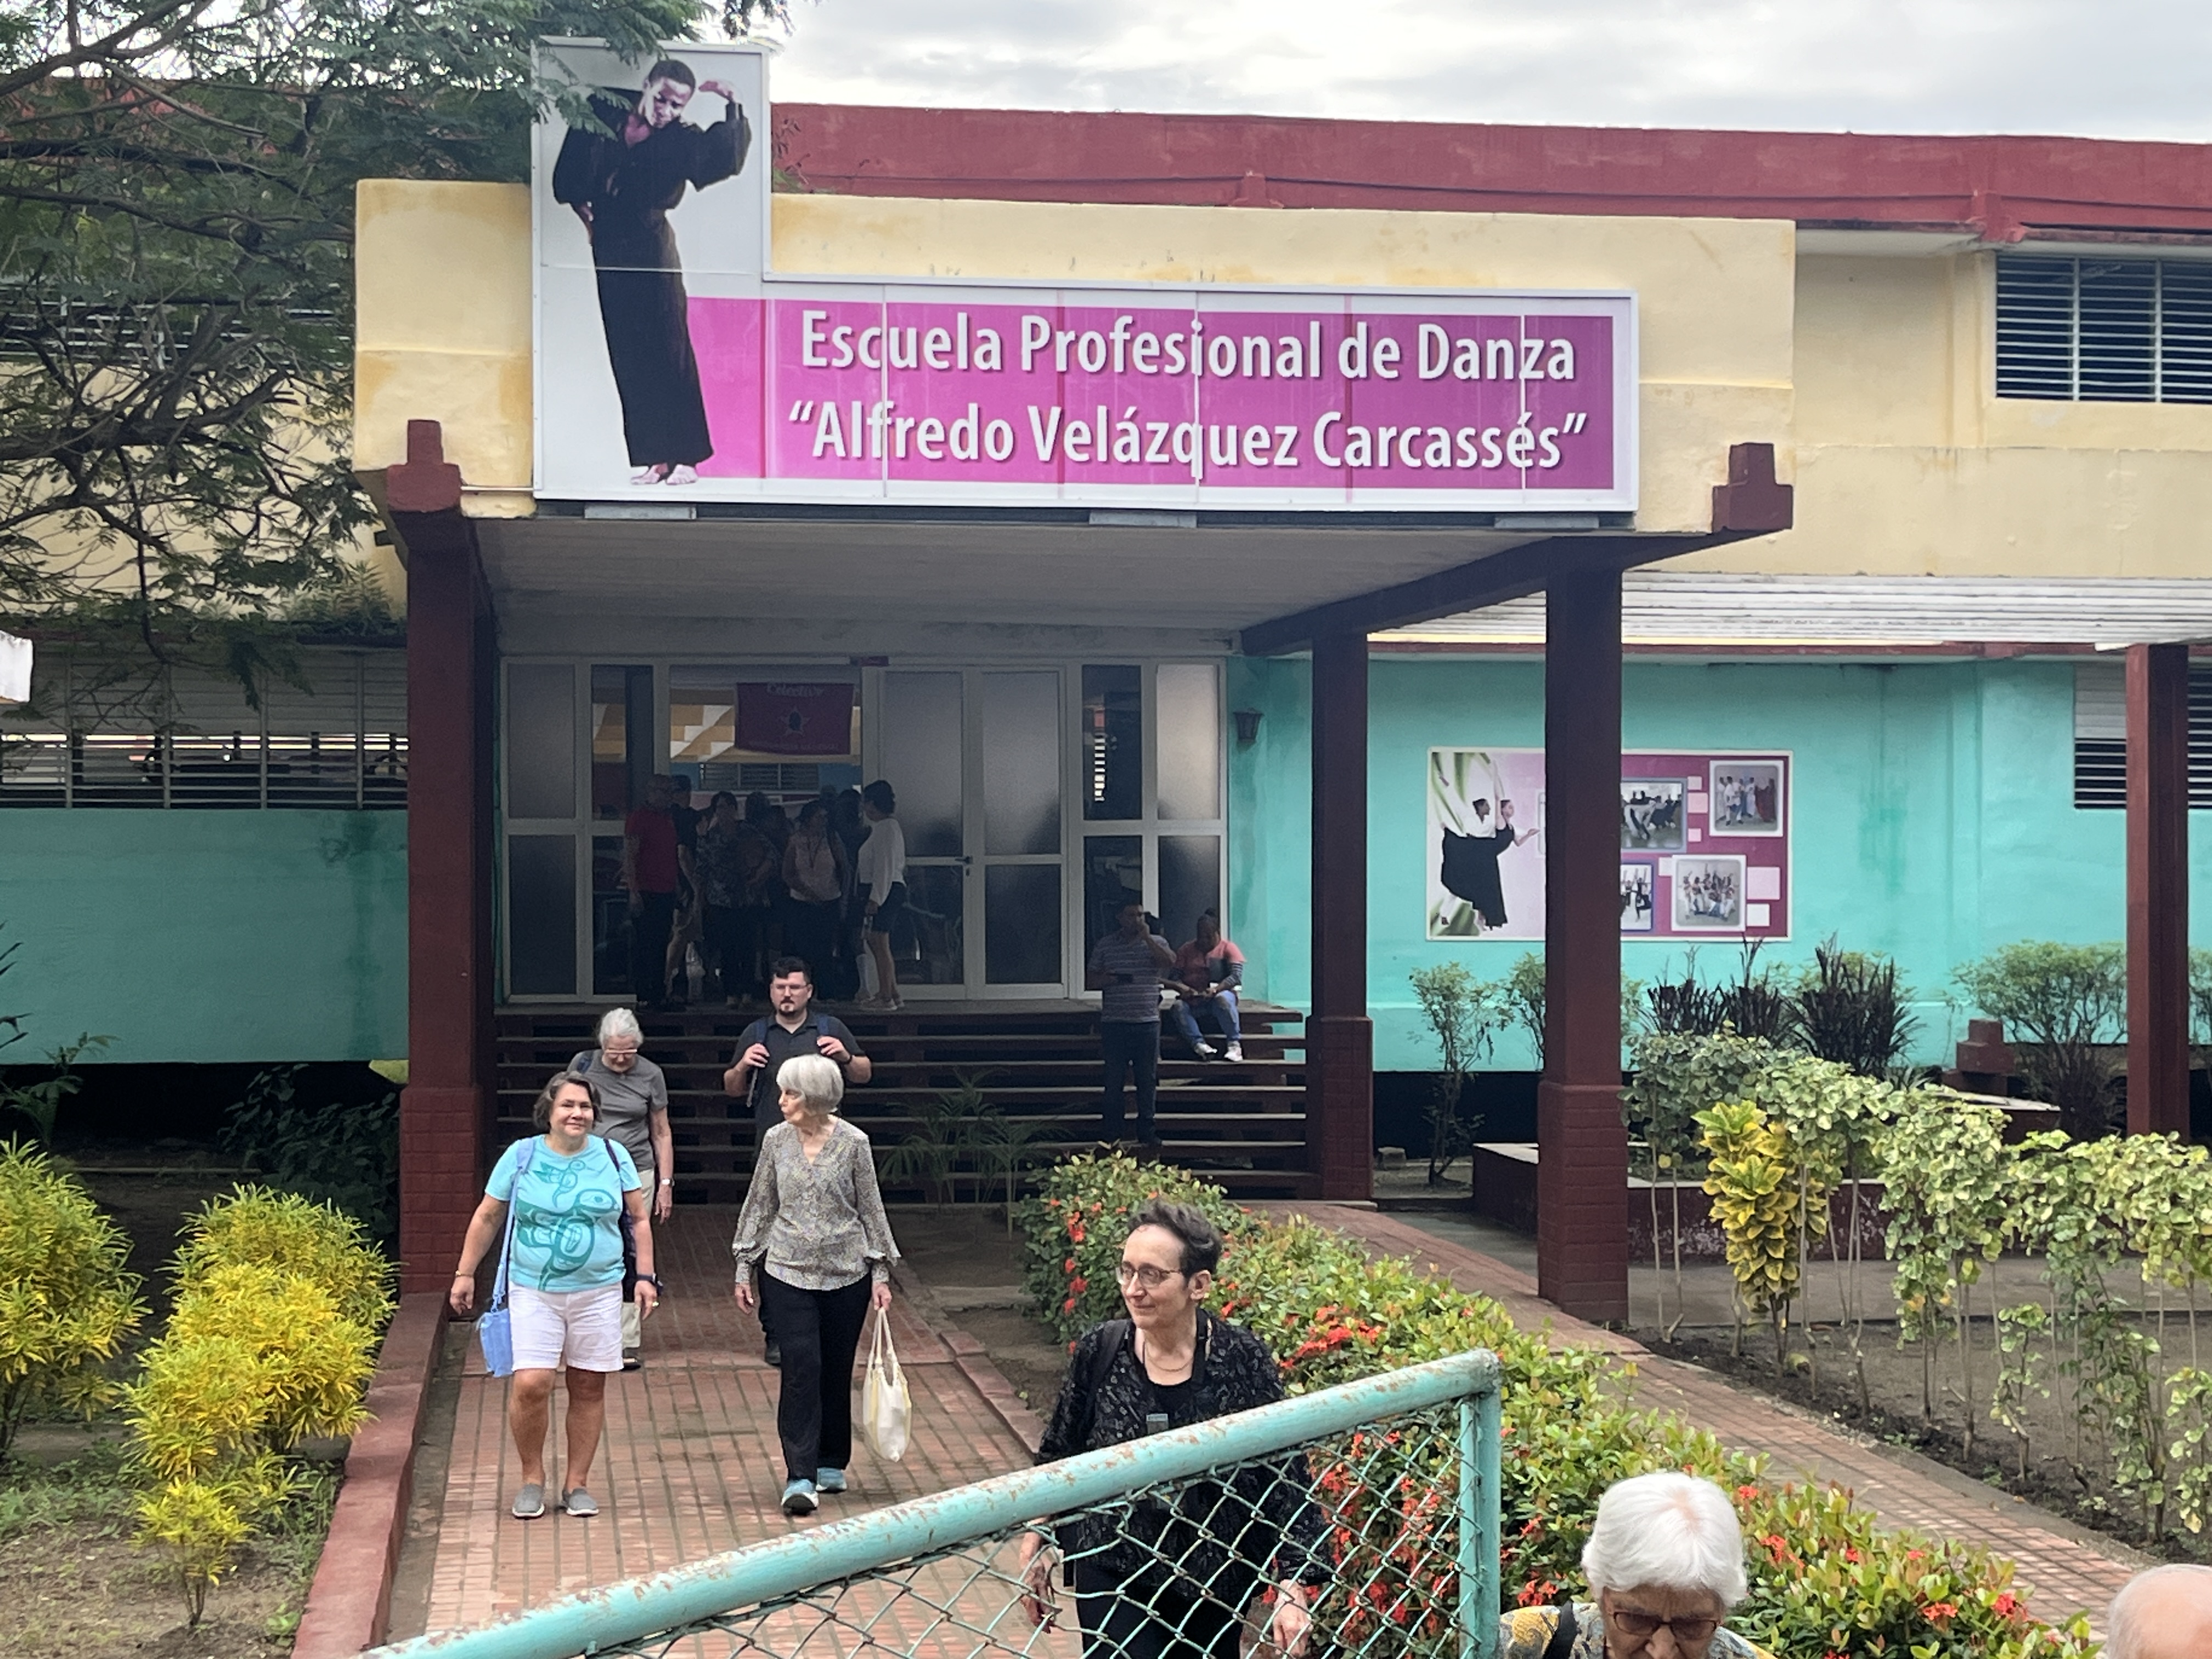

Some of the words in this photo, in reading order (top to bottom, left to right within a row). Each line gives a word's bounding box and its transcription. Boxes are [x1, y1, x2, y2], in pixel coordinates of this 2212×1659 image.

[802, 310, 1001, 371] Escuela
[1021, 315, 1321, 377] Profesional
[1338, 321, 1401, 379] de
[1418, 324, 1575, 380] Danza
[788, 400, 1014, 461] “Alfredo
[1028, 405, 1298, 481] Velázquez
[1314, 411, 1587, 468] Carcassés”
